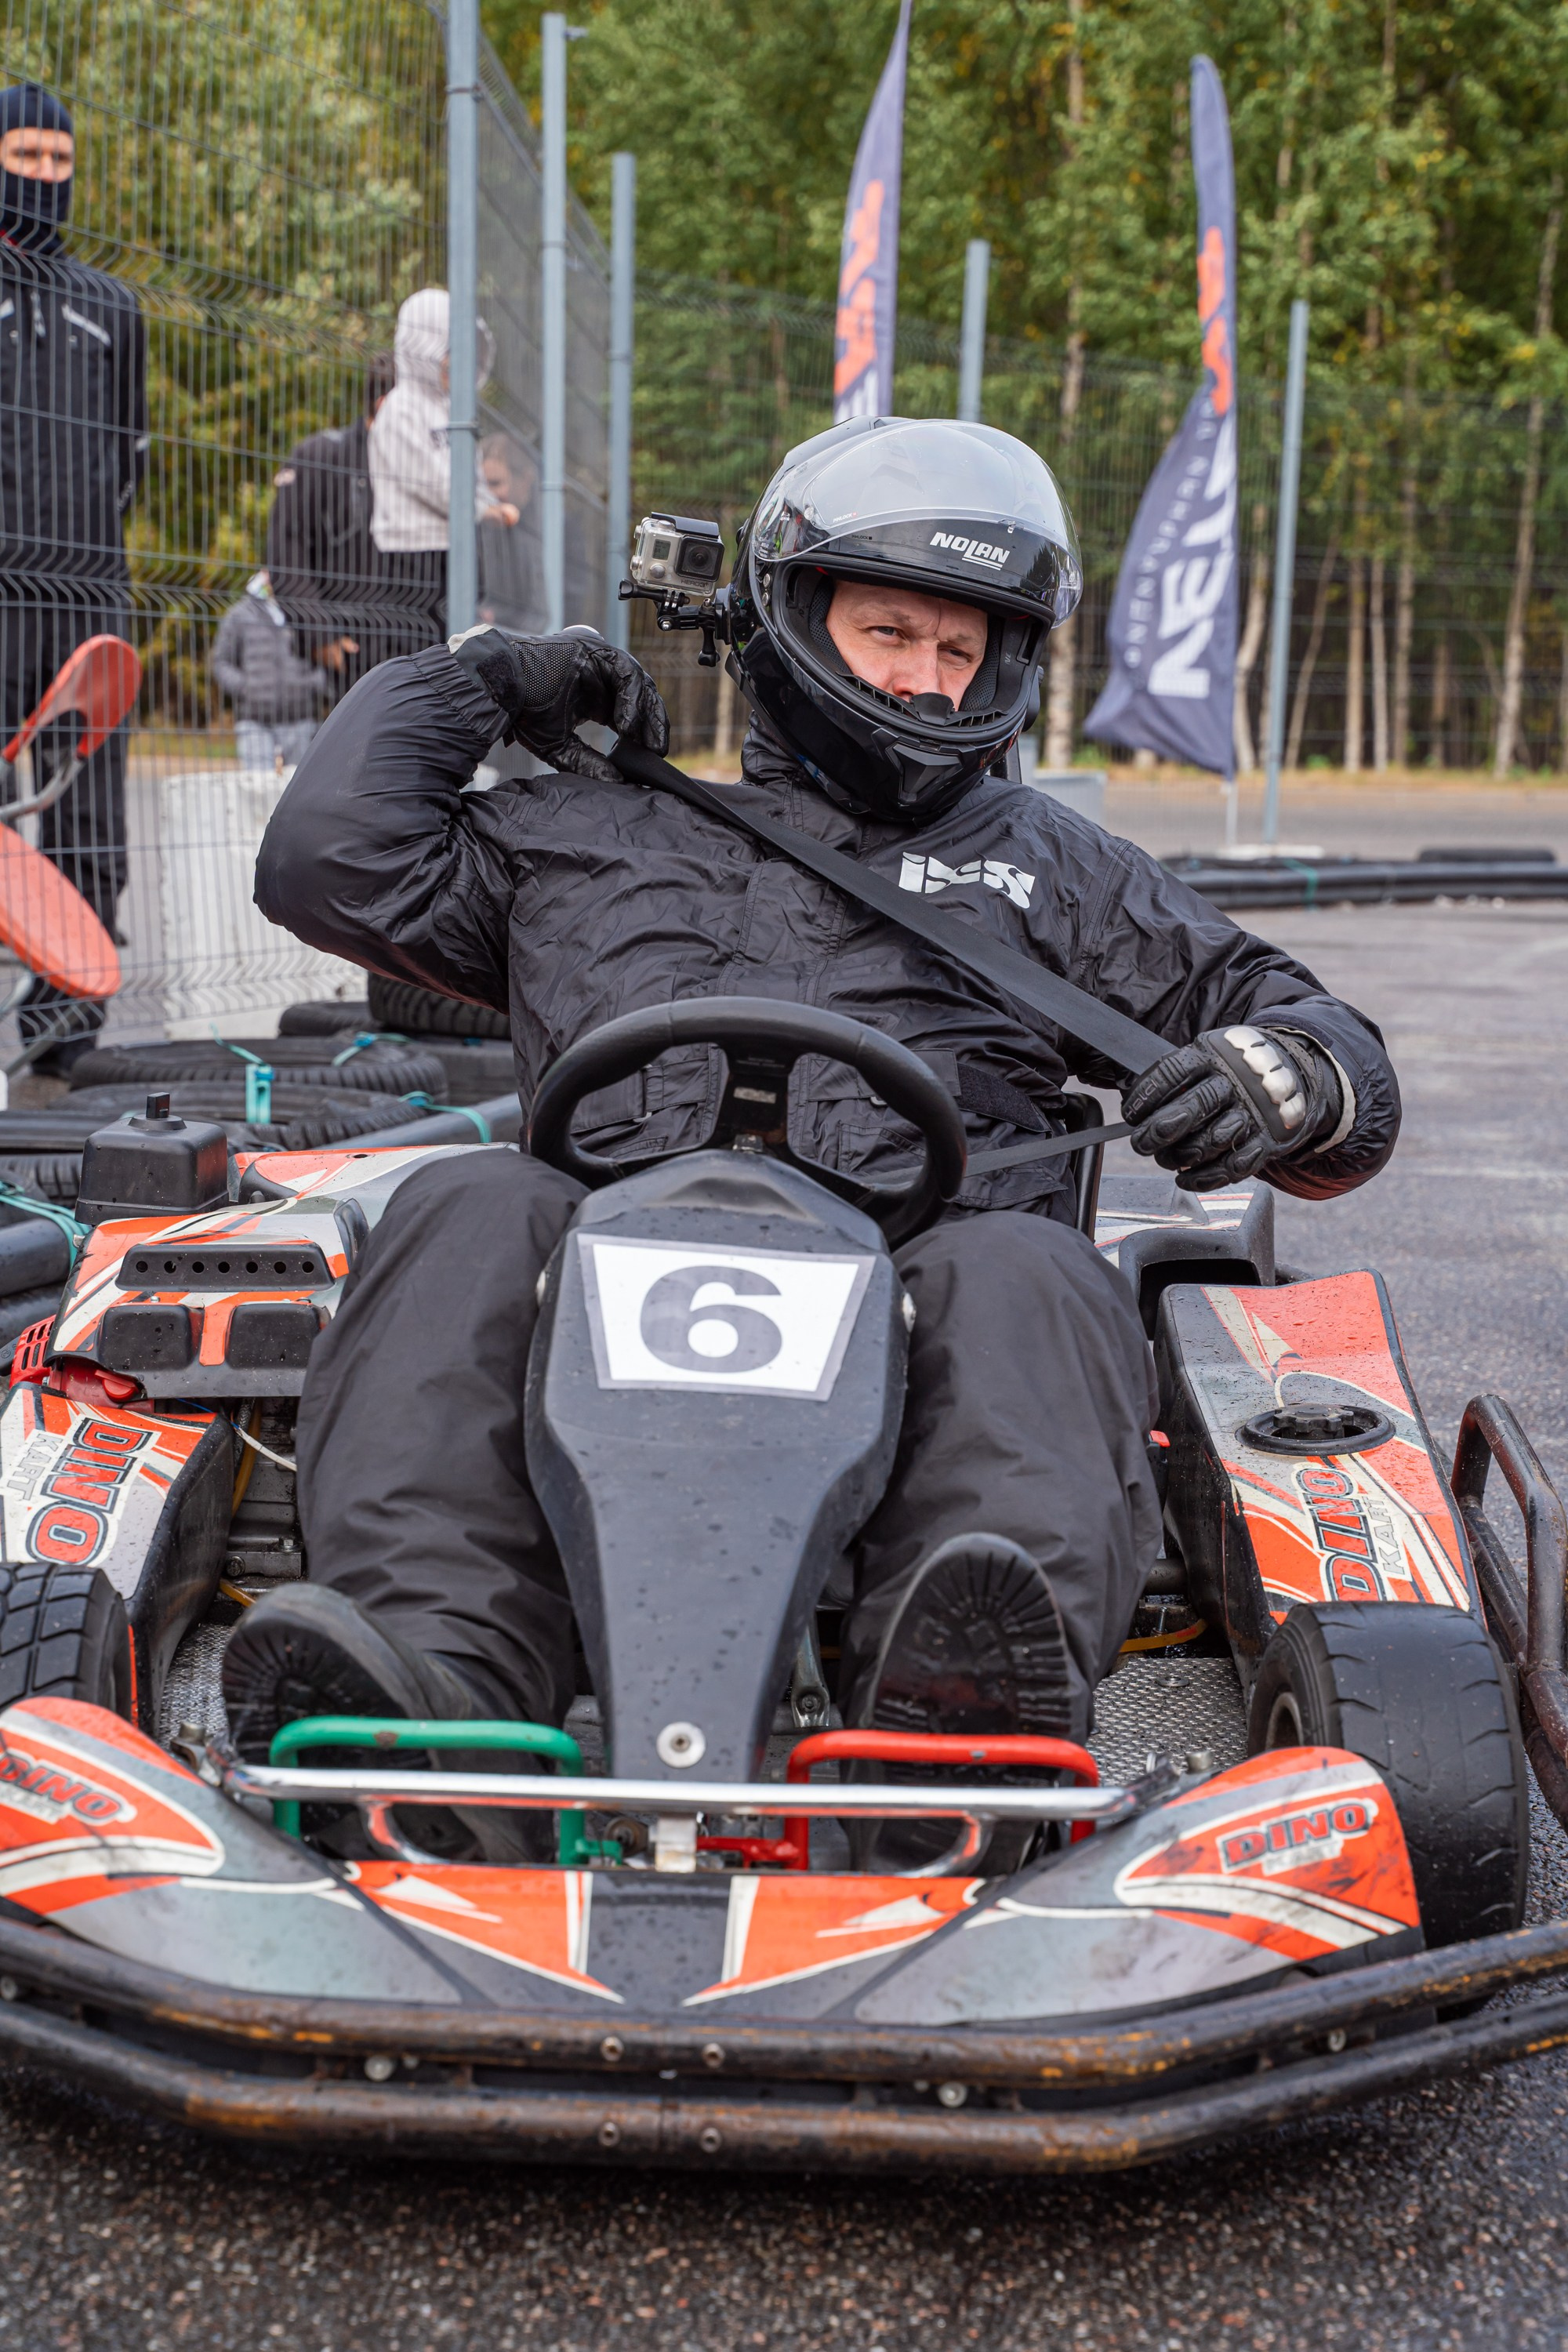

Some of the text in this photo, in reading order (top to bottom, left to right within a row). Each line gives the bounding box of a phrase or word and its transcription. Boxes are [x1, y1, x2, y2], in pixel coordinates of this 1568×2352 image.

[929, 532, 1011, 571] NOLAN
[640, 1265, 782, 1374] 6
[6, 1433, 64, 1501] KART
[25, 1417, 154, 1567] DINO
[1295, 1468, 1388, 1602] DINO
[1361, 1495, 1406, 1575] KART
[0, 1751, 123, 1820] DINO
[1222, 1803, 1370, 1867] DINO
